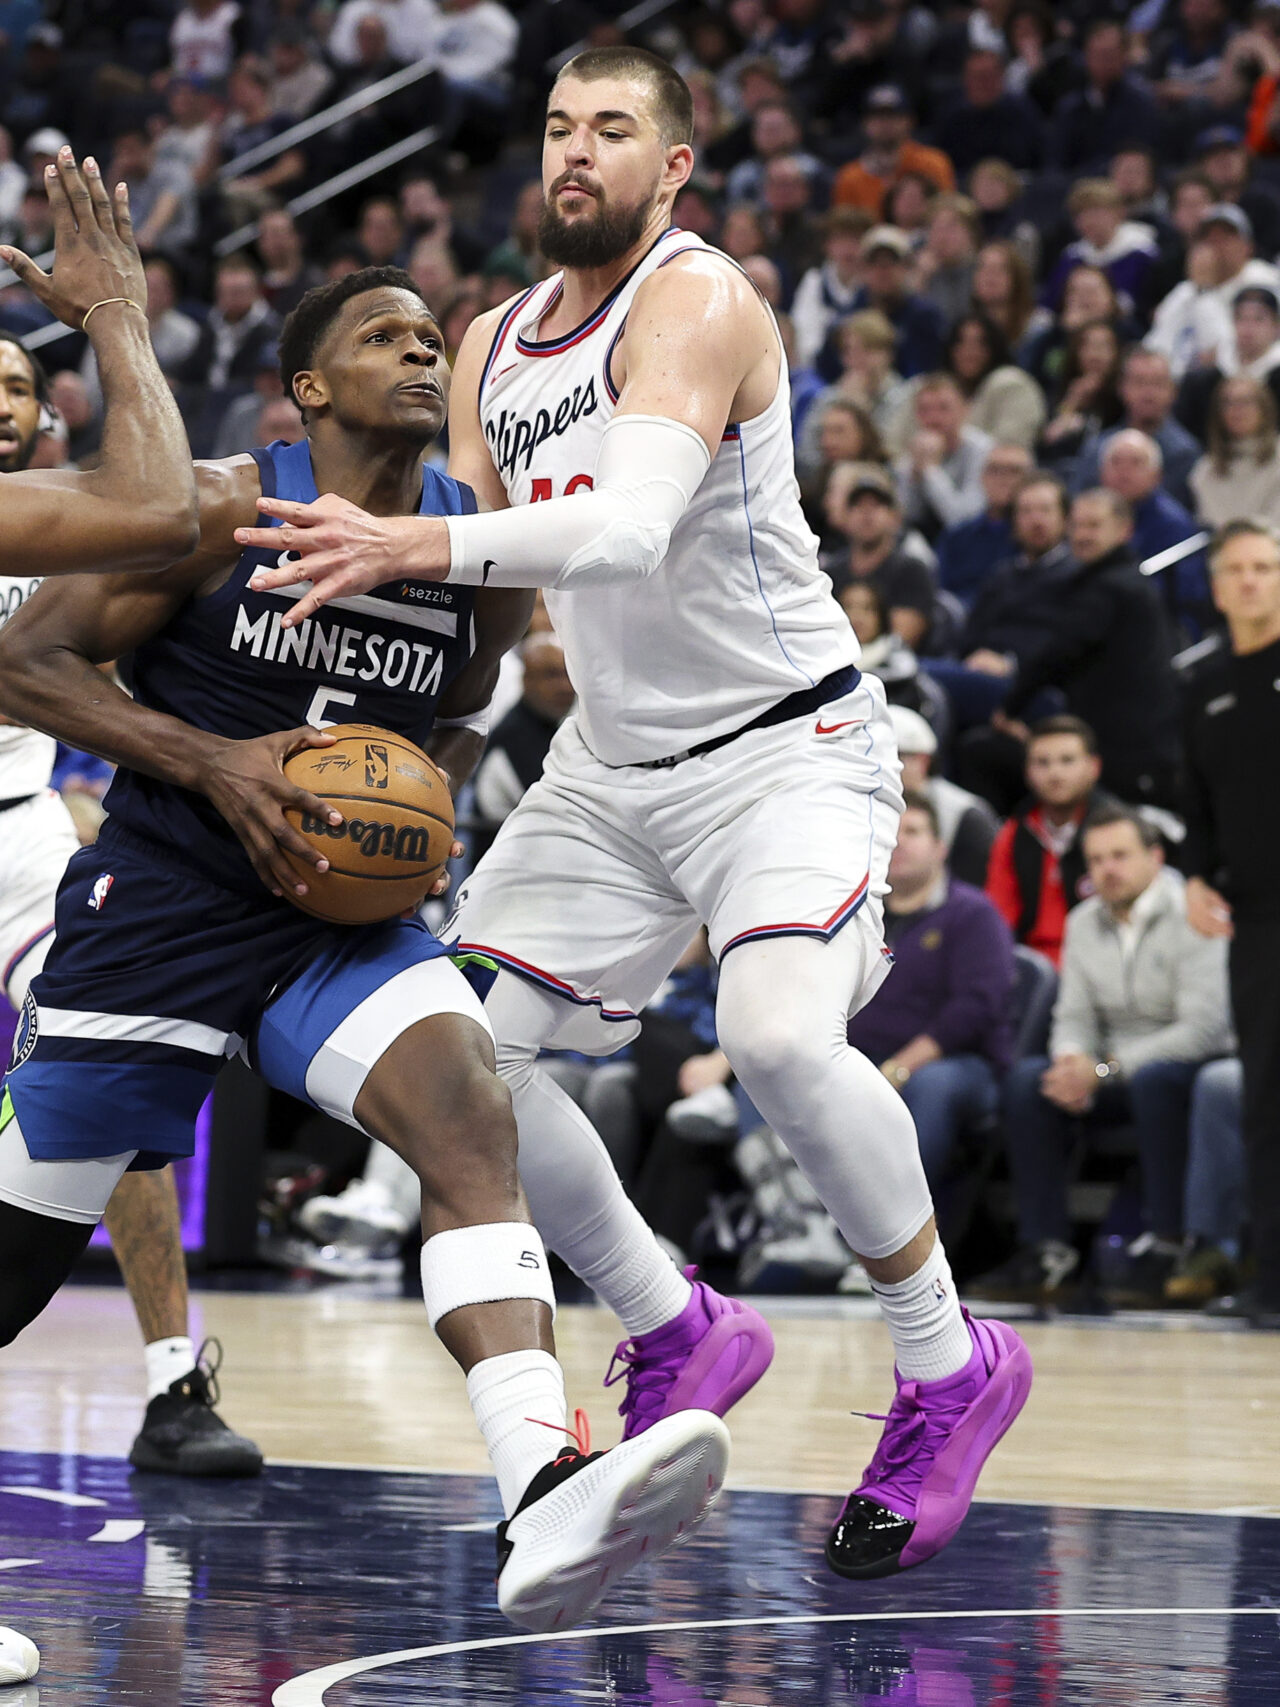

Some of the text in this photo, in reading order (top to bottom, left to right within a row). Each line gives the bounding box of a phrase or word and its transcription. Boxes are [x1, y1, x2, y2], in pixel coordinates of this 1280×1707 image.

[408, 586, 454, 605] sezzle
[230, 603, 444, 697] MINNESOTA
[301, 812, 430, 863] Wilson
